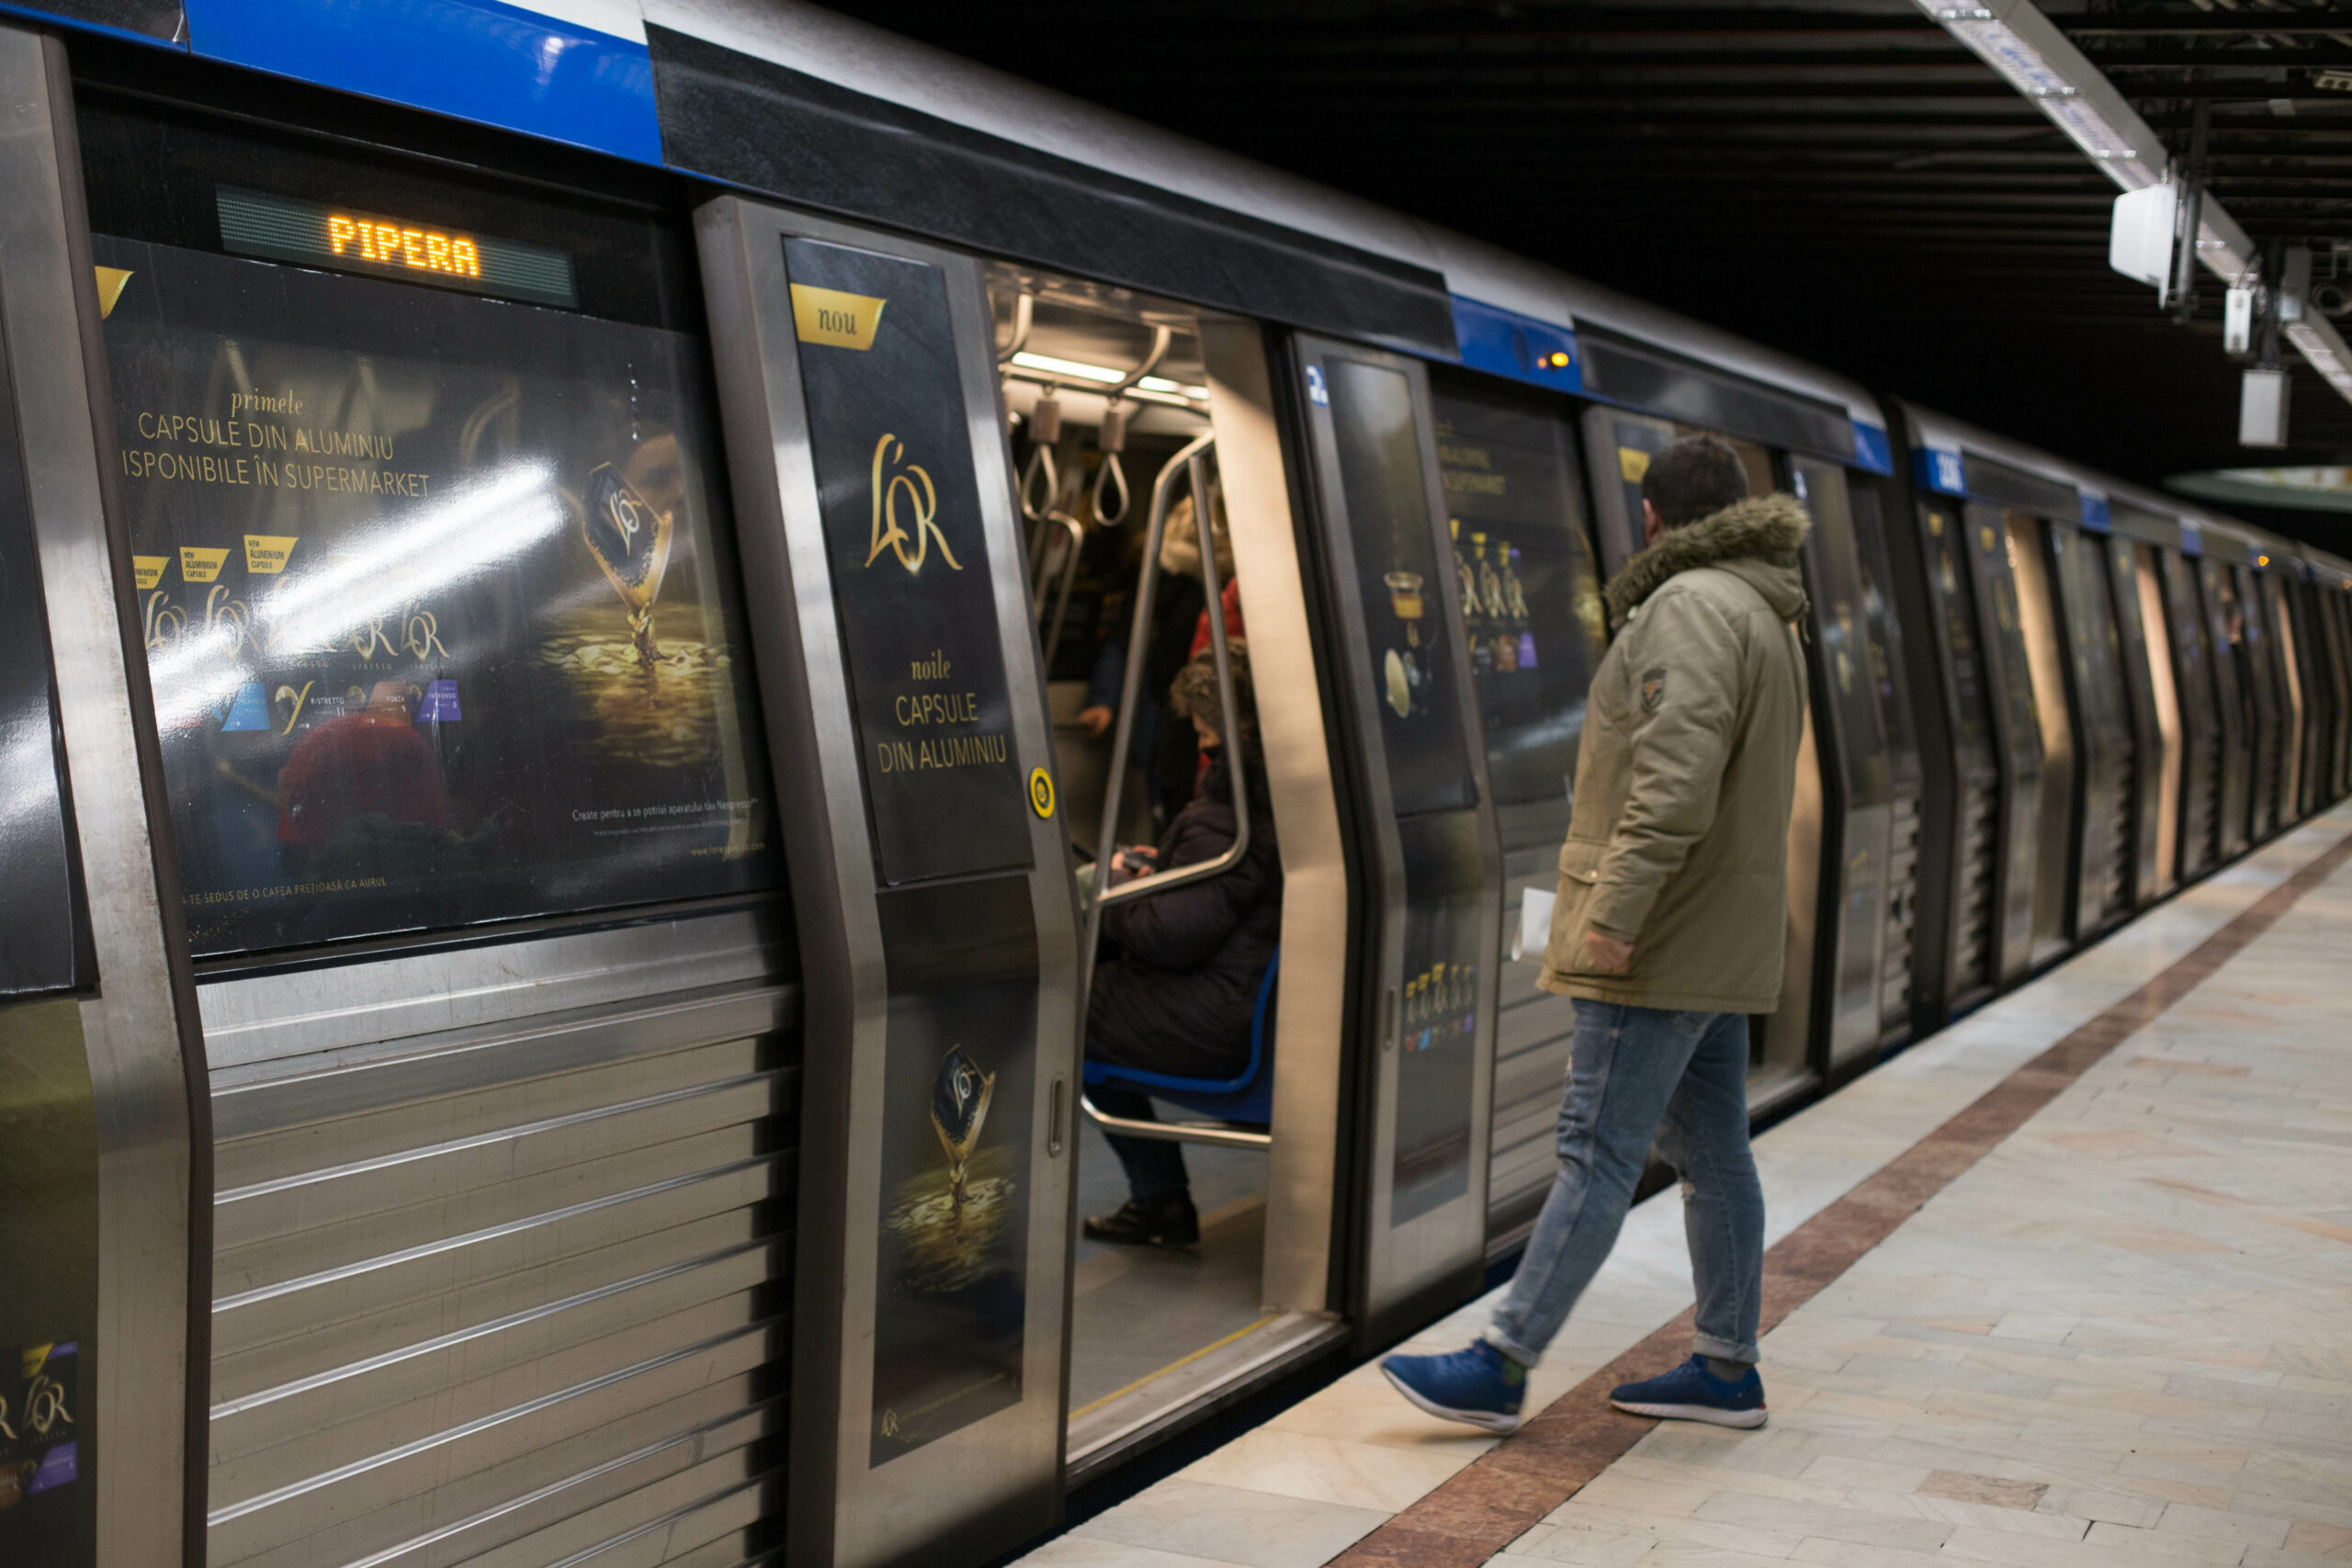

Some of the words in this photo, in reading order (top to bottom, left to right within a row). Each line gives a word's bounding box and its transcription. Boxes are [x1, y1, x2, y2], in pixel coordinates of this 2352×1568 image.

[329, 217, 479, 276] PIPERA
[818, 309, 857, 335] nou
[231, 388, 303, 418] primele
[138, 412, 242, 447] CAPSULE
[249, 423, 288, 450] DIN
[294, 428, 393, 461] ALUMINIU
[254, 455, 279, 487] ÎN
[285, 463, 430, 498] SUPERMARKET
[911, 649, 951, 680] noile
[311, 696, 345, 705] RISTRETTO
[895, 693, 979, 727] CAPSULE
[877, 741, 915, 773] DIN
[921, 735, 1007, 770] ALUMINIU
[571, 808, 598, 822] Create
[600, 808, 626, 823] pentru
[633, 807, 641, 817] se
[643, 803, 667, 818] potrivi
[204, 891, 234, 904] SEDUS
[236, 890, 250, 901] DE
[252, 888, 260, 898] O
[262, 886, 292, 898] CAFEA
[345, 880, 357, 890] CA
[359, 876, 388, 888] AURUL
